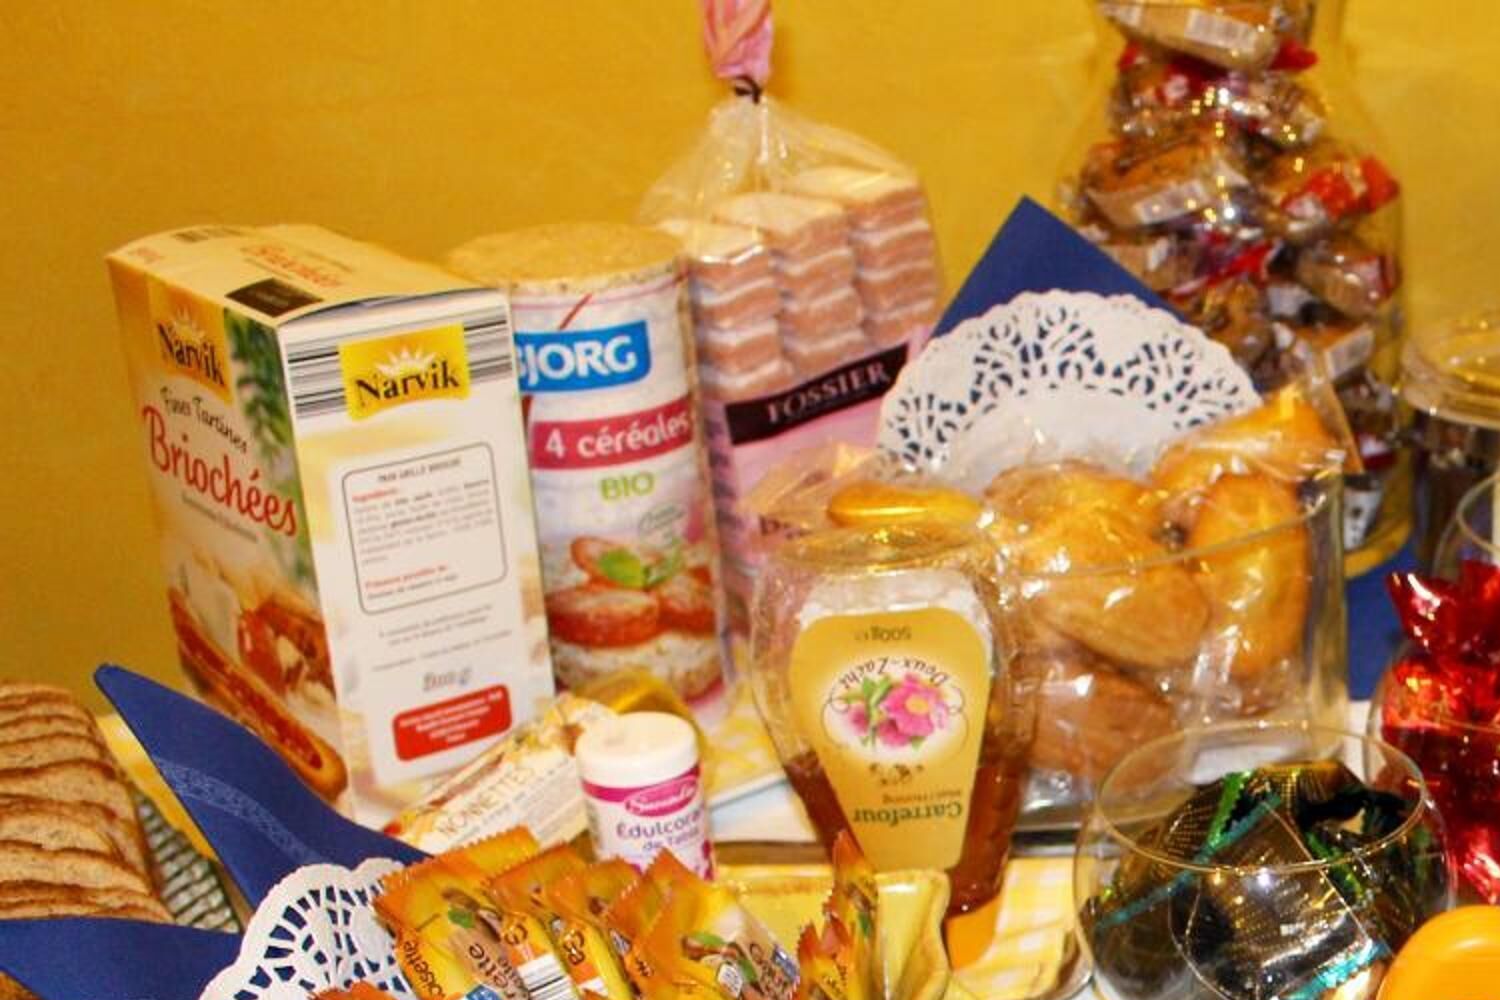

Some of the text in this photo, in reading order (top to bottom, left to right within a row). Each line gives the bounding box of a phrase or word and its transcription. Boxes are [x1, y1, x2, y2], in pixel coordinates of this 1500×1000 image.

[157, 322, 225, 387] Narvik
[353, 370, 462, 406] Narvik
[766, 361, 891, 424] FOSSIER
[545, 411, 691, 459] 4 céréales
[141, 404, 298, 537] Briochées
[599, 471, 656, 500] BIO
[853, 800, 963, 828] Carrefour
[403, 940, 446, 998] oisette
